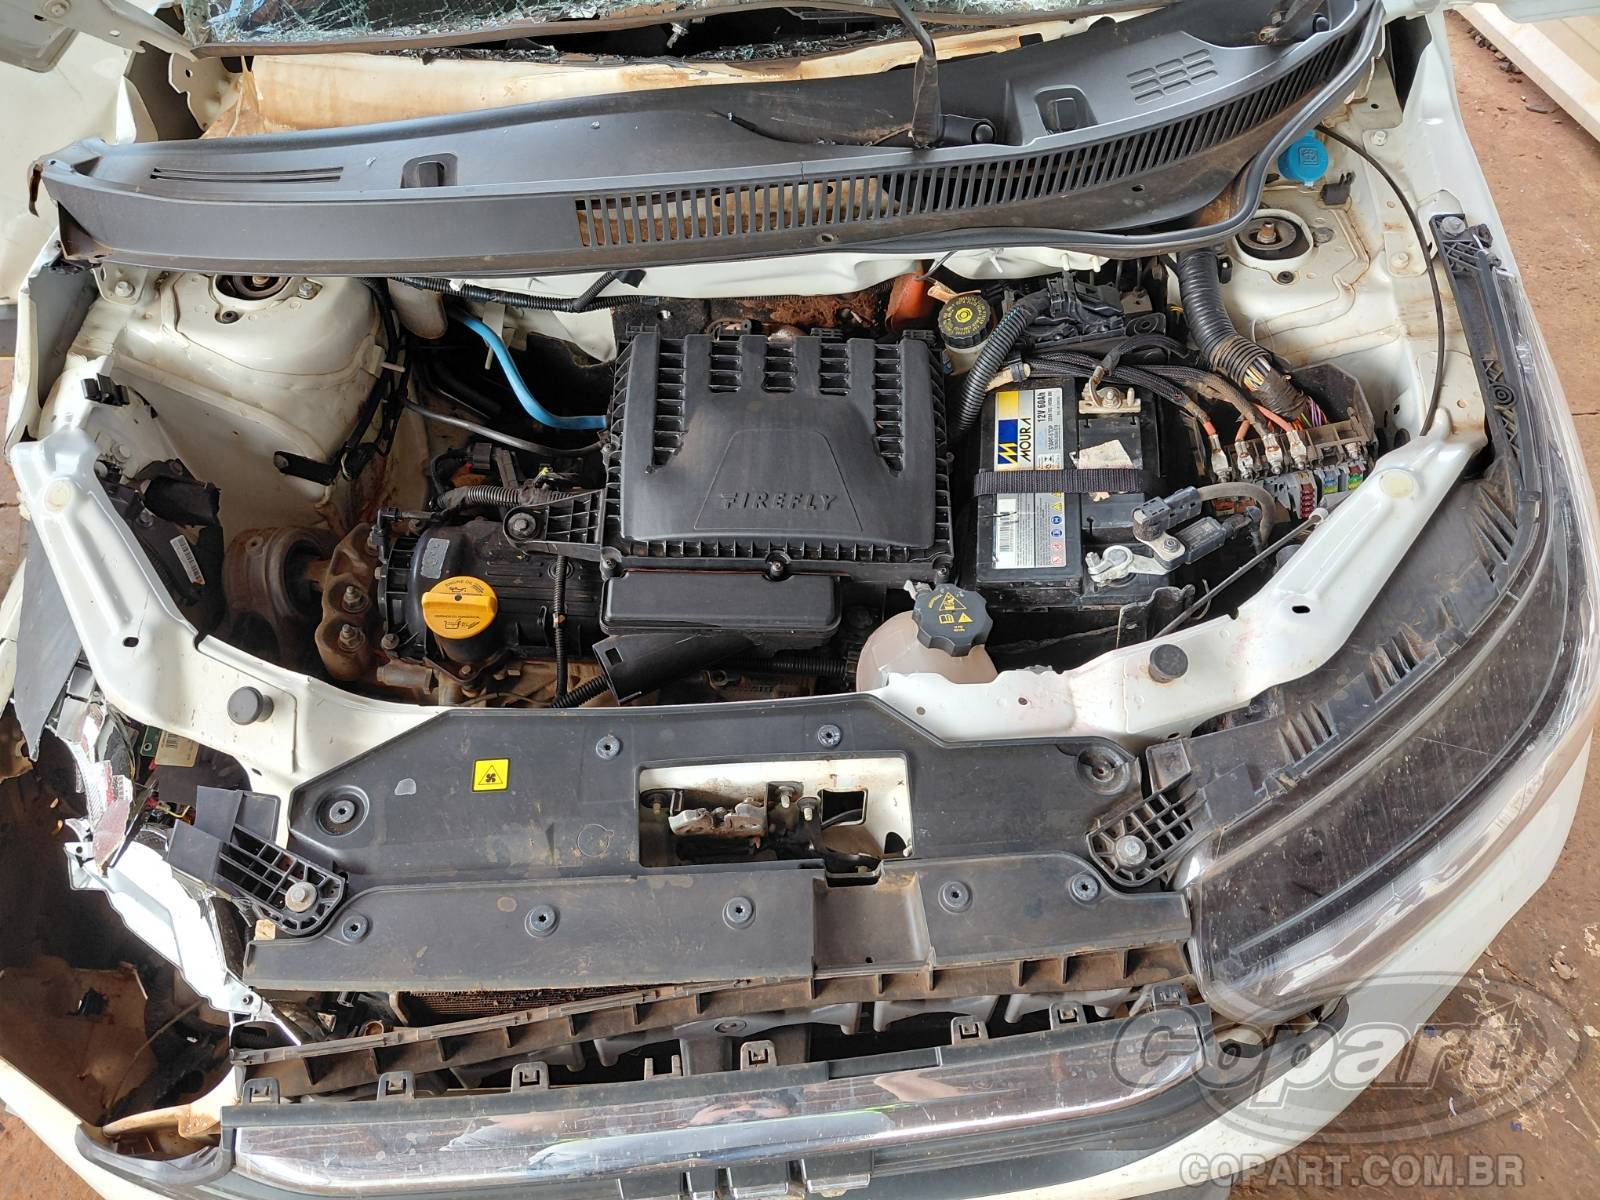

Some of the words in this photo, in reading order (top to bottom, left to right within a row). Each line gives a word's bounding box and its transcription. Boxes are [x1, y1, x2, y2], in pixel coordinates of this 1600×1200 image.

[1037, 392, 1046, 409] 60Ah
[1037, 410, 1046, 422] 12V
[1019, 417, 1032, 462] MOURA
[720, 491, 838, 511] FIREFLY
